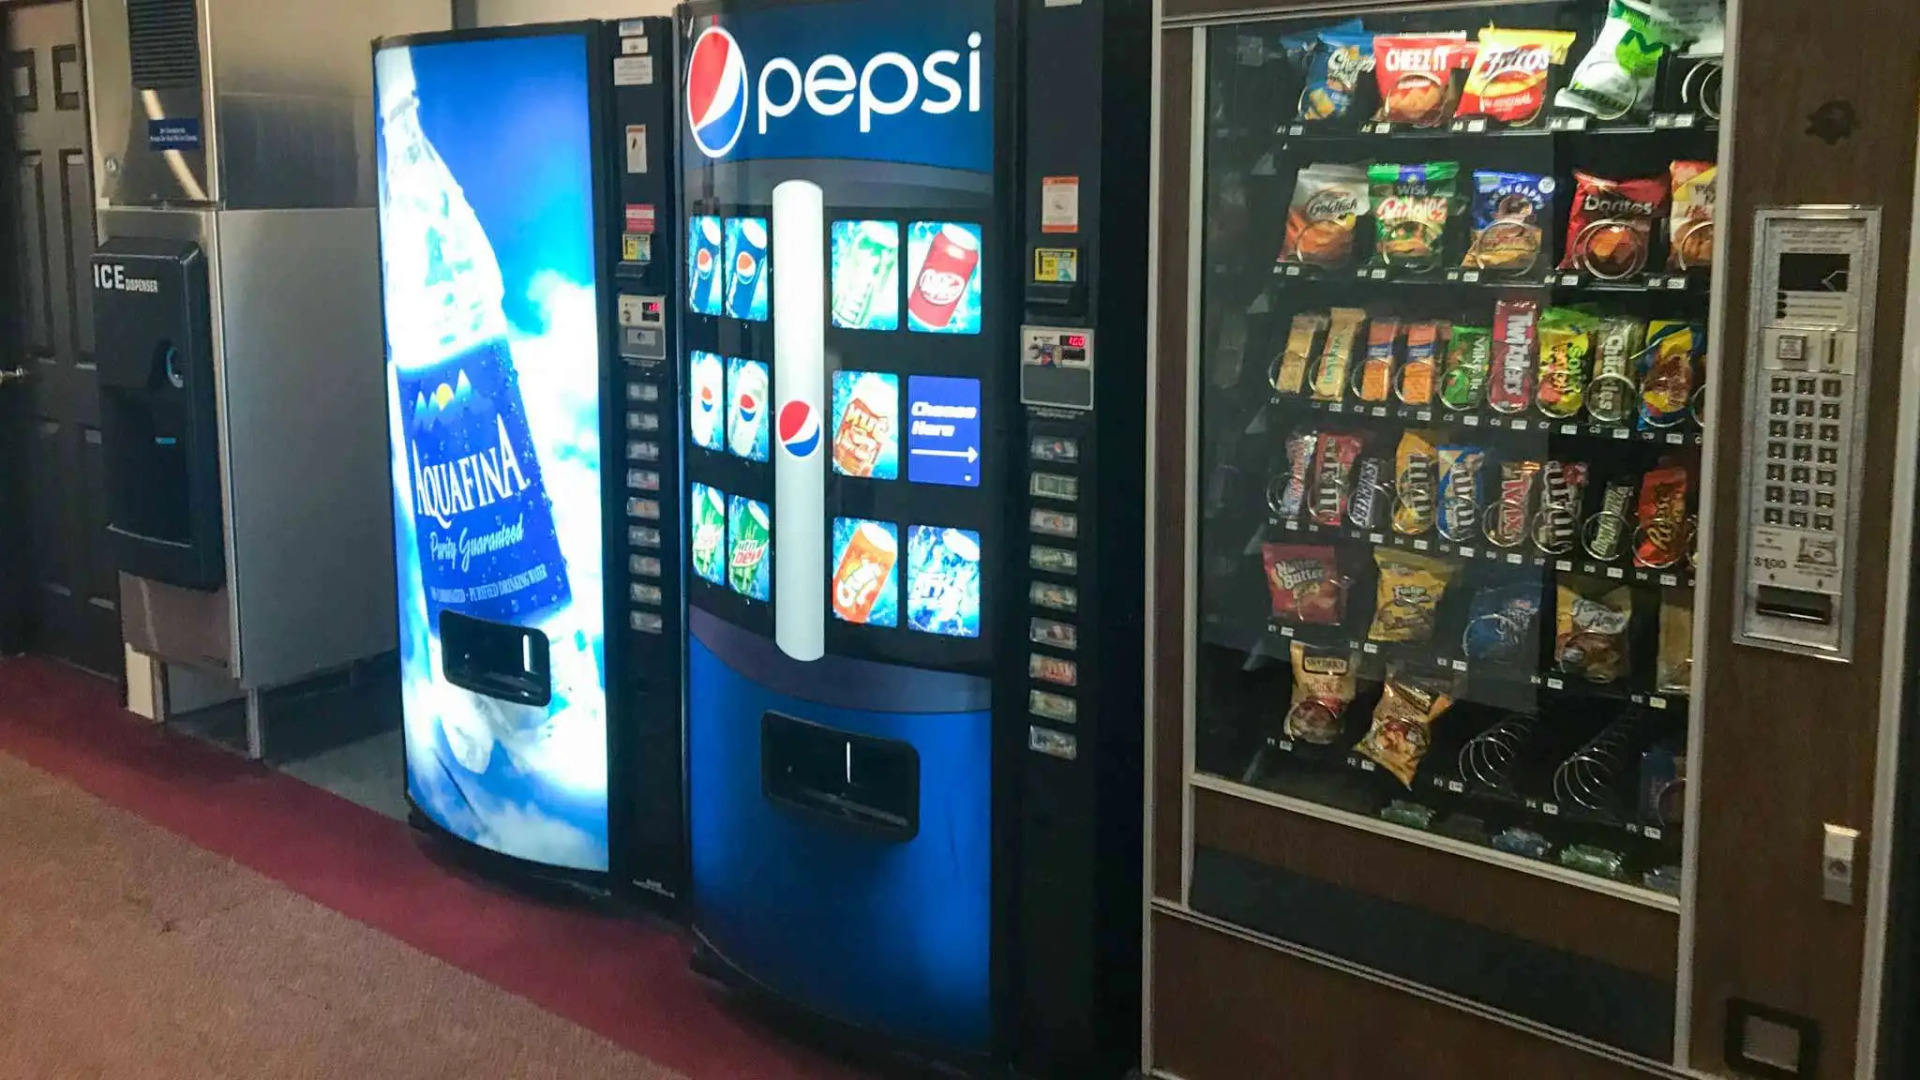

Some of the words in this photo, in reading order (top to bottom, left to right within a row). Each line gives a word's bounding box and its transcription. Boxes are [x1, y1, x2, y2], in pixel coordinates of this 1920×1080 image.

[758, 31, 982, 134] pepsi
[1481, 47, 1550, 80] Fritos
[1308, 198, 1359, 217] Goldfish
[1583, 194, 1653, 217] Doritos
[94, 263, 125, 290] ICE
[125, 278, 158, 293] DISPENSER
[1598, 333, 1625, 411] Chucles
[412, 412, 530, 529] AQUAFINA
[429, 531, 457, 569] Purity
[458, 512, 524, 572] Guaranteed
